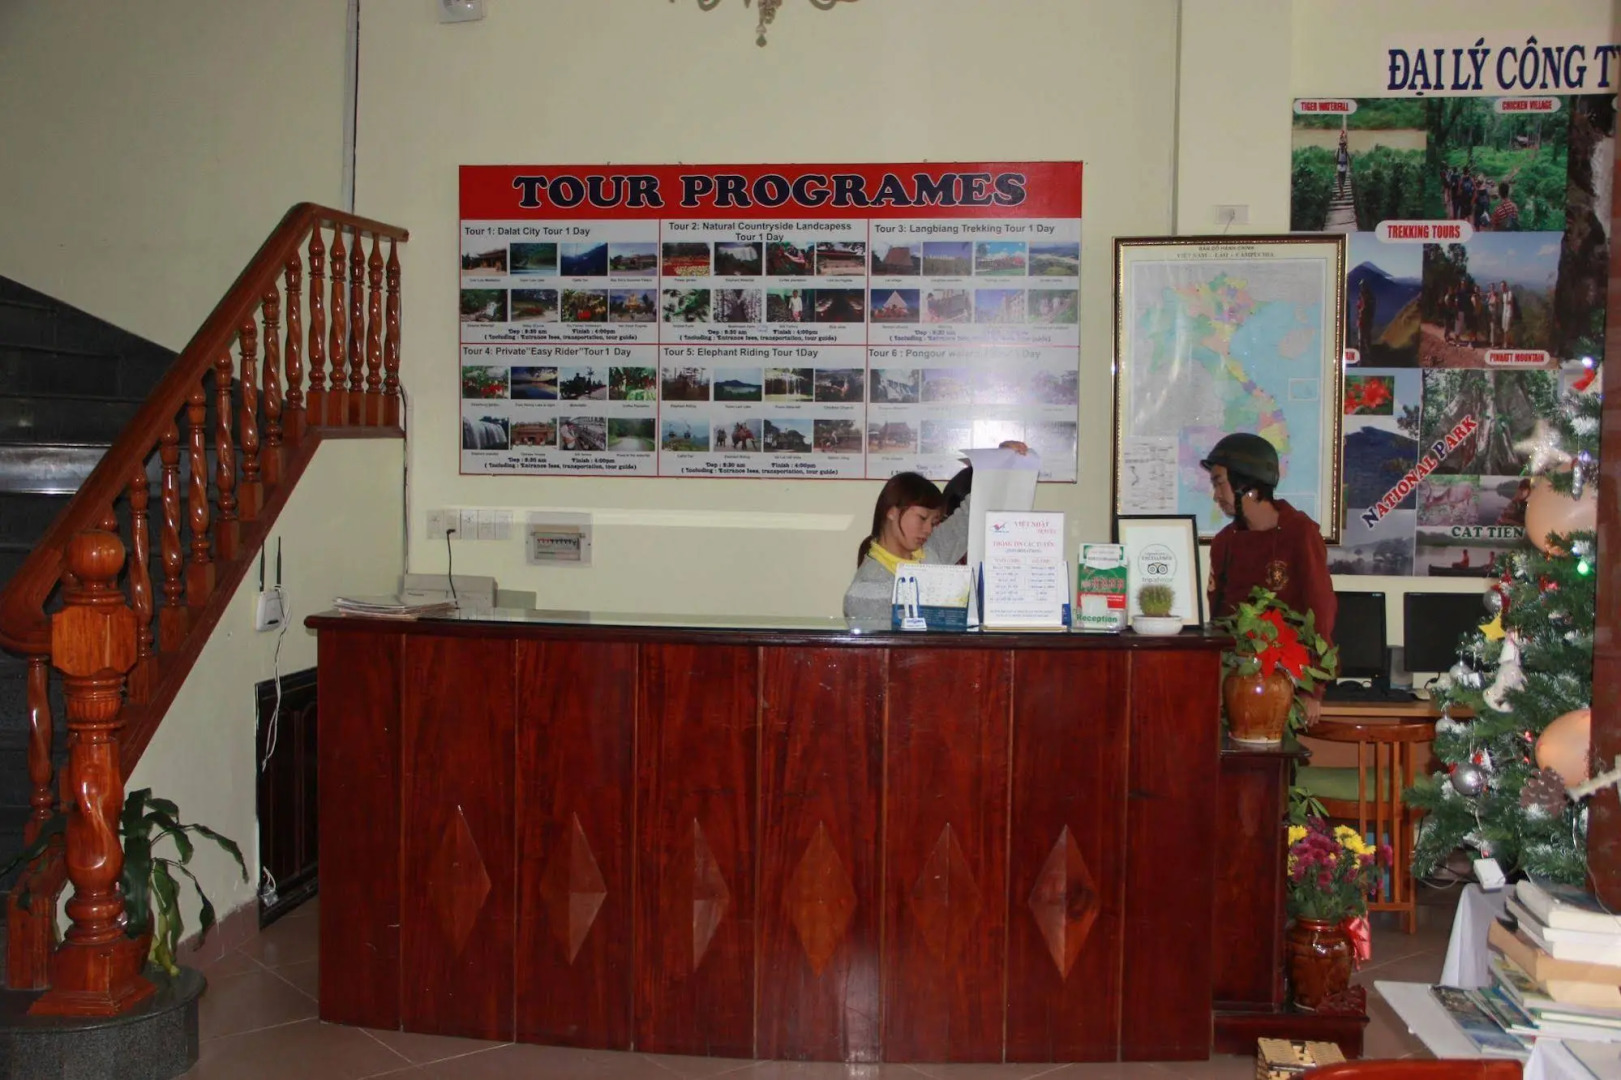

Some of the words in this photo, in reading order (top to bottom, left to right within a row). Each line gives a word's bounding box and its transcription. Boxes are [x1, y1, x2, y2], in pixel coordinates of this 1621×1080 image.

[1387, 48, 1444, 96] ĐẠI
[1451, 37, 1490, 90] LÝ
[1496, 35, 1587, 90] CÔNG
[1594, 45, 1621, 88] T
[1530, 100, 1552, 110] VILLAGE
[512, 175, 664, 208] TOUR
[679, 173, 1027, 208] PROGRAMES
[523, 227, 540, 237] City
[574, 227, 590, 236] Day
[738, 222, 793, 232] Countryside
[796, 222, 851, 232] Landcapess
[910, 224, 958, 234] Langbiang
[962, 224, 1001, 234] Trekking
[1037, 224, 1054, 234] Day
[1388, 225, 1430, 239] TREKKING
[1432, 225, 1460, 239] TOURS
[767, 233, 784, 242] Day
[615, 348, 631, 357] Day
[698, 348, 737, 358] Elephant
[741, 348, 769, 358] Riding
[906, 349, 945, 358] Pongour
[1361, 456, 1438, 528] NATIONAL
[1432, 414, 1478, 461] PARK
[1452, 526, 1483, 538] CAT
[1488, 526, 1524, 538] TIEN
[1076, 614, 1118, 623] Reception
